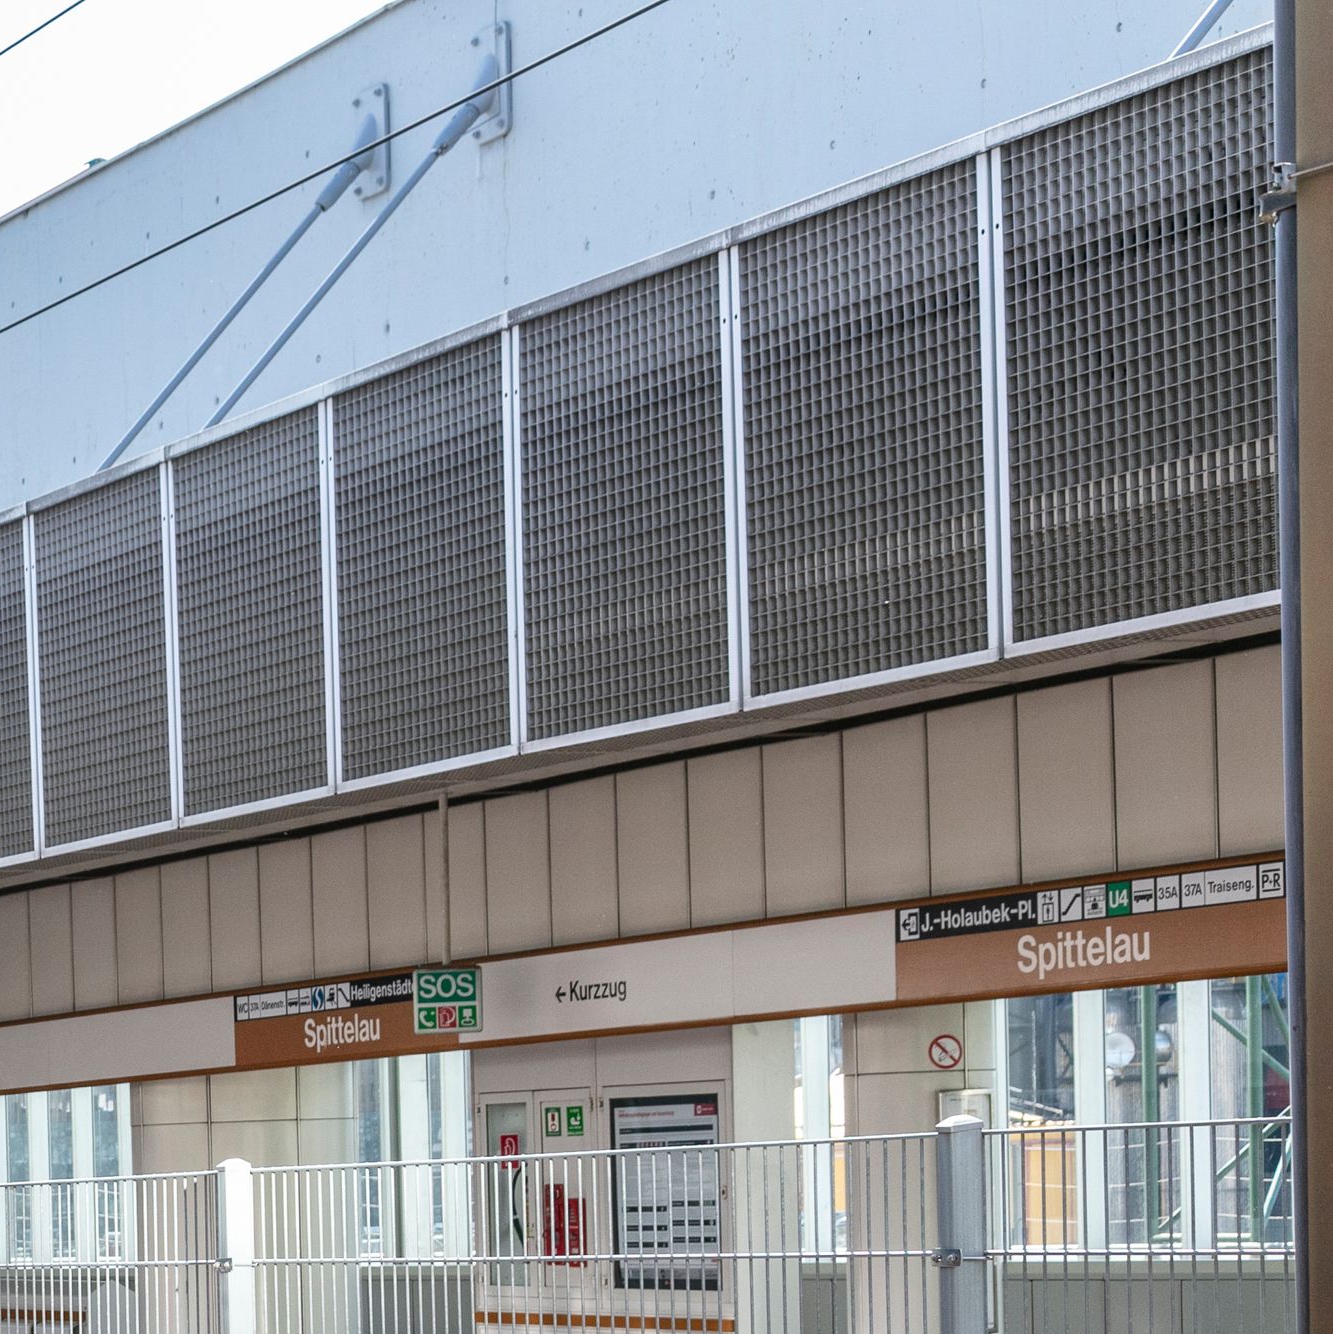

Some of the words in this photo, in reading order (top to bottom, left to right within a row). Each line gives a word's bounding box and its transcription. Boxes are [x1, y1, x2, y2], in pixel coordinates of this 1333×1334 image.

[921, 900, 1036, 932] J.-Holaubek-Pl.
[1109, 889, 1129, 908] U4
[1158, 886, 1178, 900] 35A
[1184, 883, 1202, 897] 37A
[1208, 878, 1254, 894] Traiseng.
[1016, 926, 1151, 980] Spittelau
[351, 978, 414, 1001] Heiligenstädt
[419, 973, 474, 999] SOS
[569, 980, 627, 1001] Kurzzug
[304, 1013, 381, 1053] Spittelau
